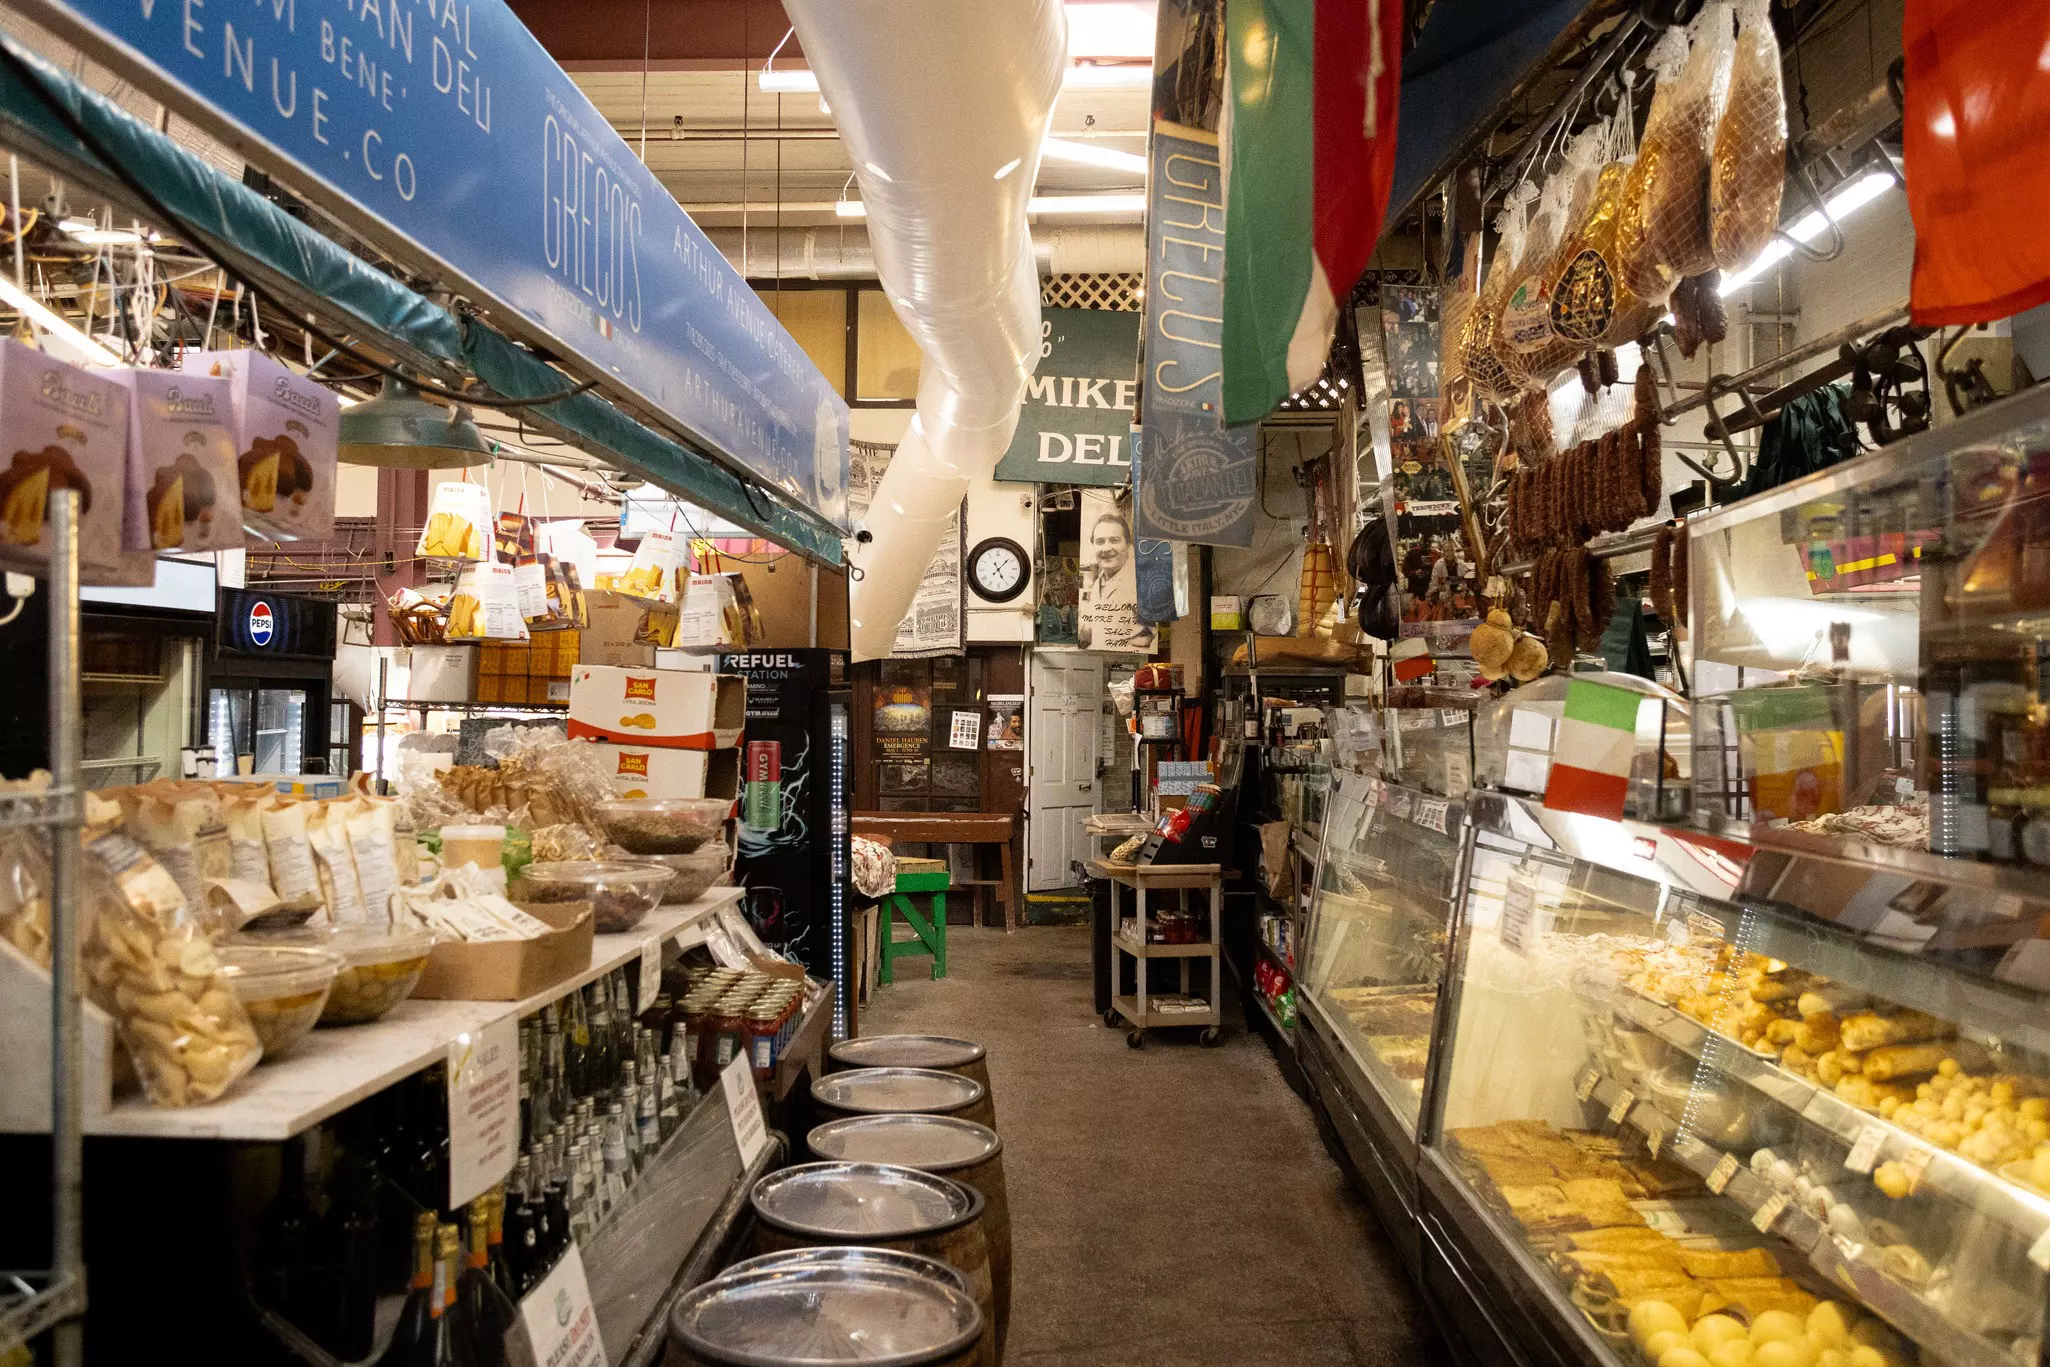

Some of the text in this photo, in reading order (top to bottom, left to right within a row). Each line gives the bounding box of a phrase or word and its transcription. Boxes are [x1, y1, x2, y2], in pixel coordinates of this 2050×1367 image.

[544, 114, 642, 334] GRECO'S
[673, 225, 723, 302] ARTHUR
[726, 285, 765, 350] AVENUE
[251, 618, 272, 629] PEPSI
[730, 654, 797, 668] REFUEL
[737, 670, 788, 680] STATION
[627, 688, 653, 696] CARLO
[625, 757, 642, 765] SAN
[759, 753, 768, 781] GYM
